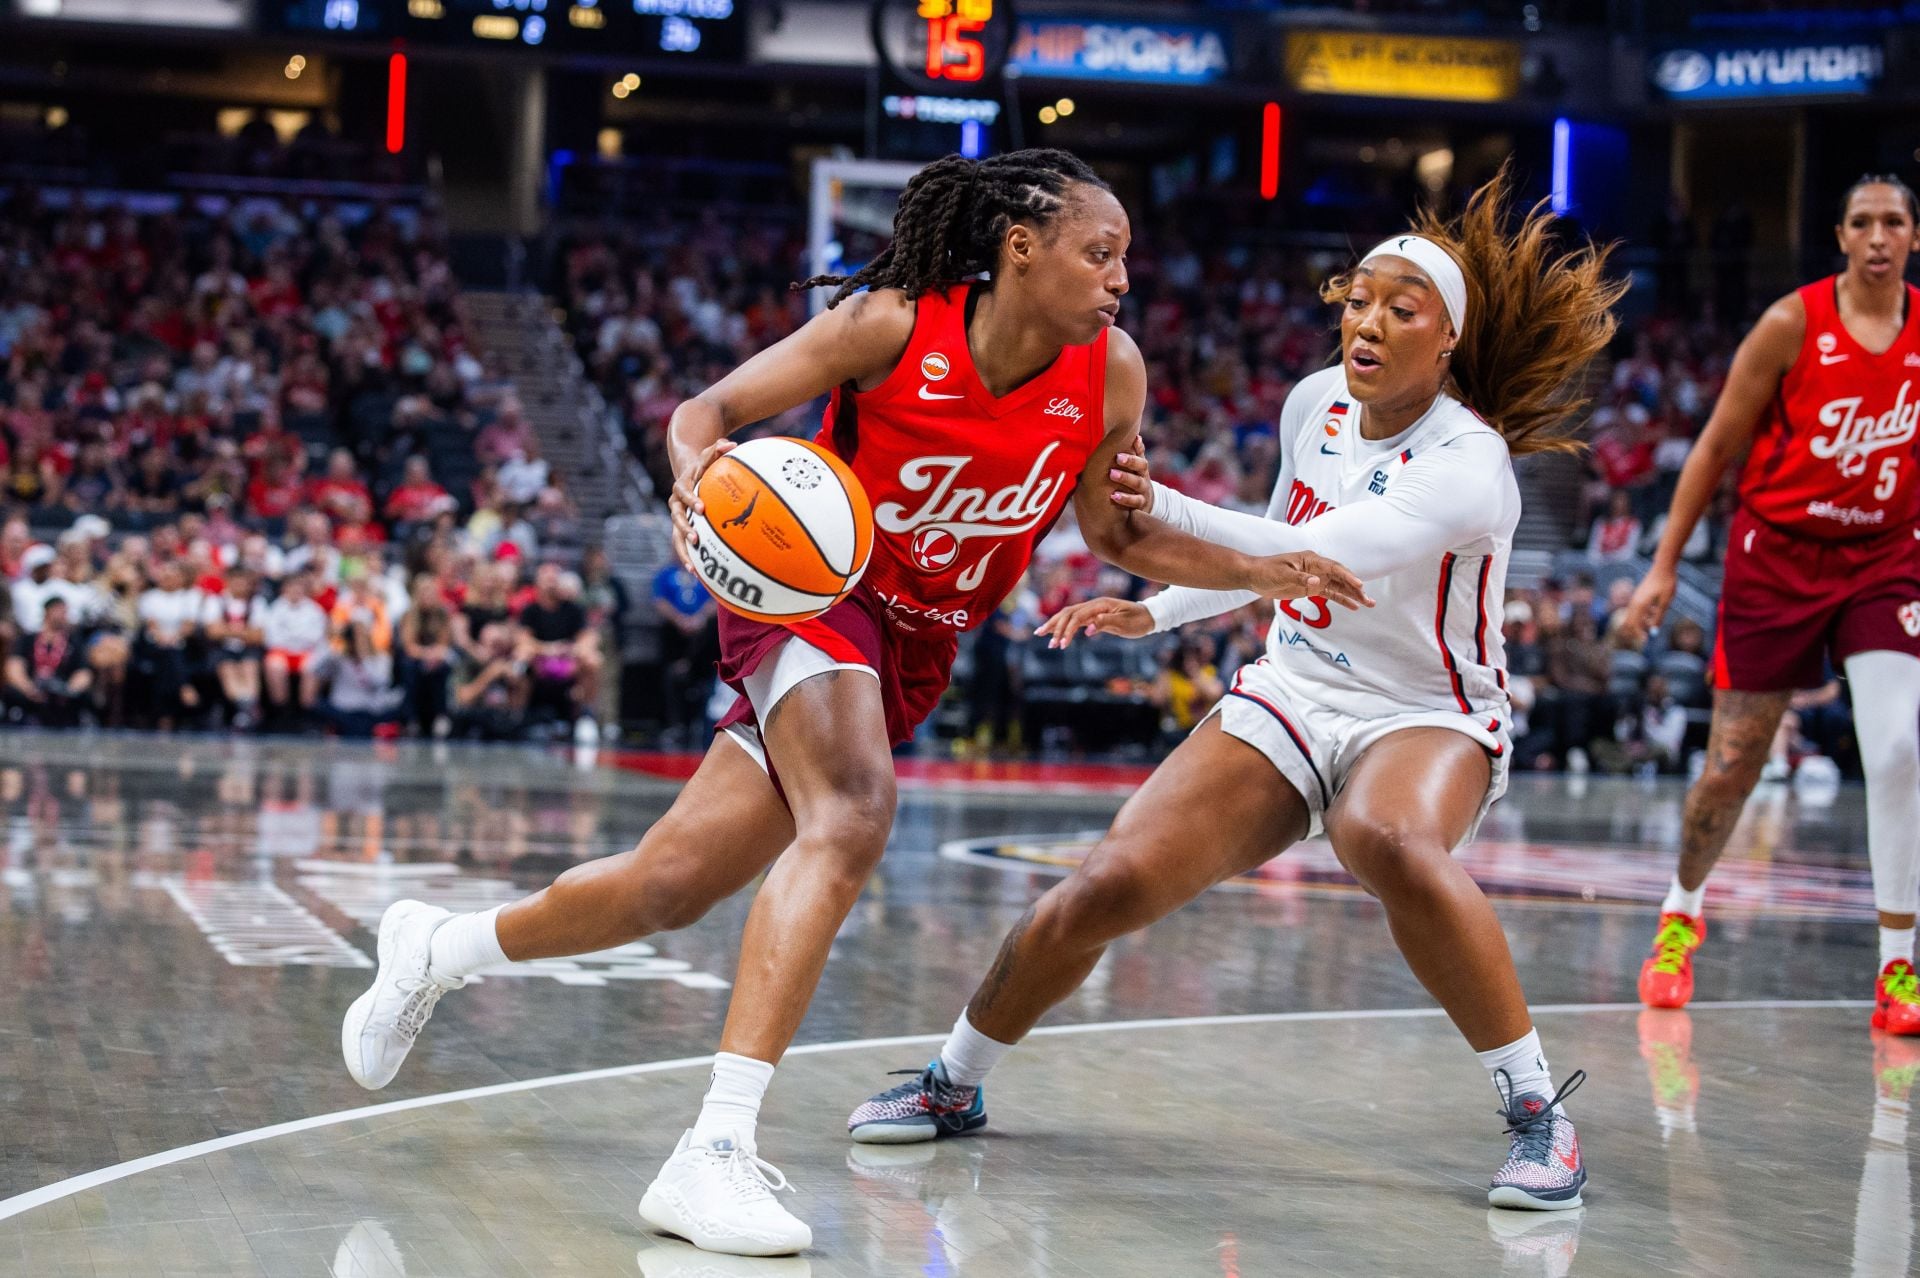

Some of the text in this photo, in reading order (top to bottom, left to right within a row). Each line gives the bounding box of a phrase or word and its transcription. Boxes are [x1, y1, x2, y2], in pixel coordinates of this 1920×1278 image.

[926, 13, 985, 81] 15
[1715, 45, 1885, 86] HYUNDAI
[1043, 397, 1084, 424] Lilly
[1809, 379, 1920, 459] Indy
[873, 440, 1066, 543] Indy
[1873, 456, 1900, 501] 5
